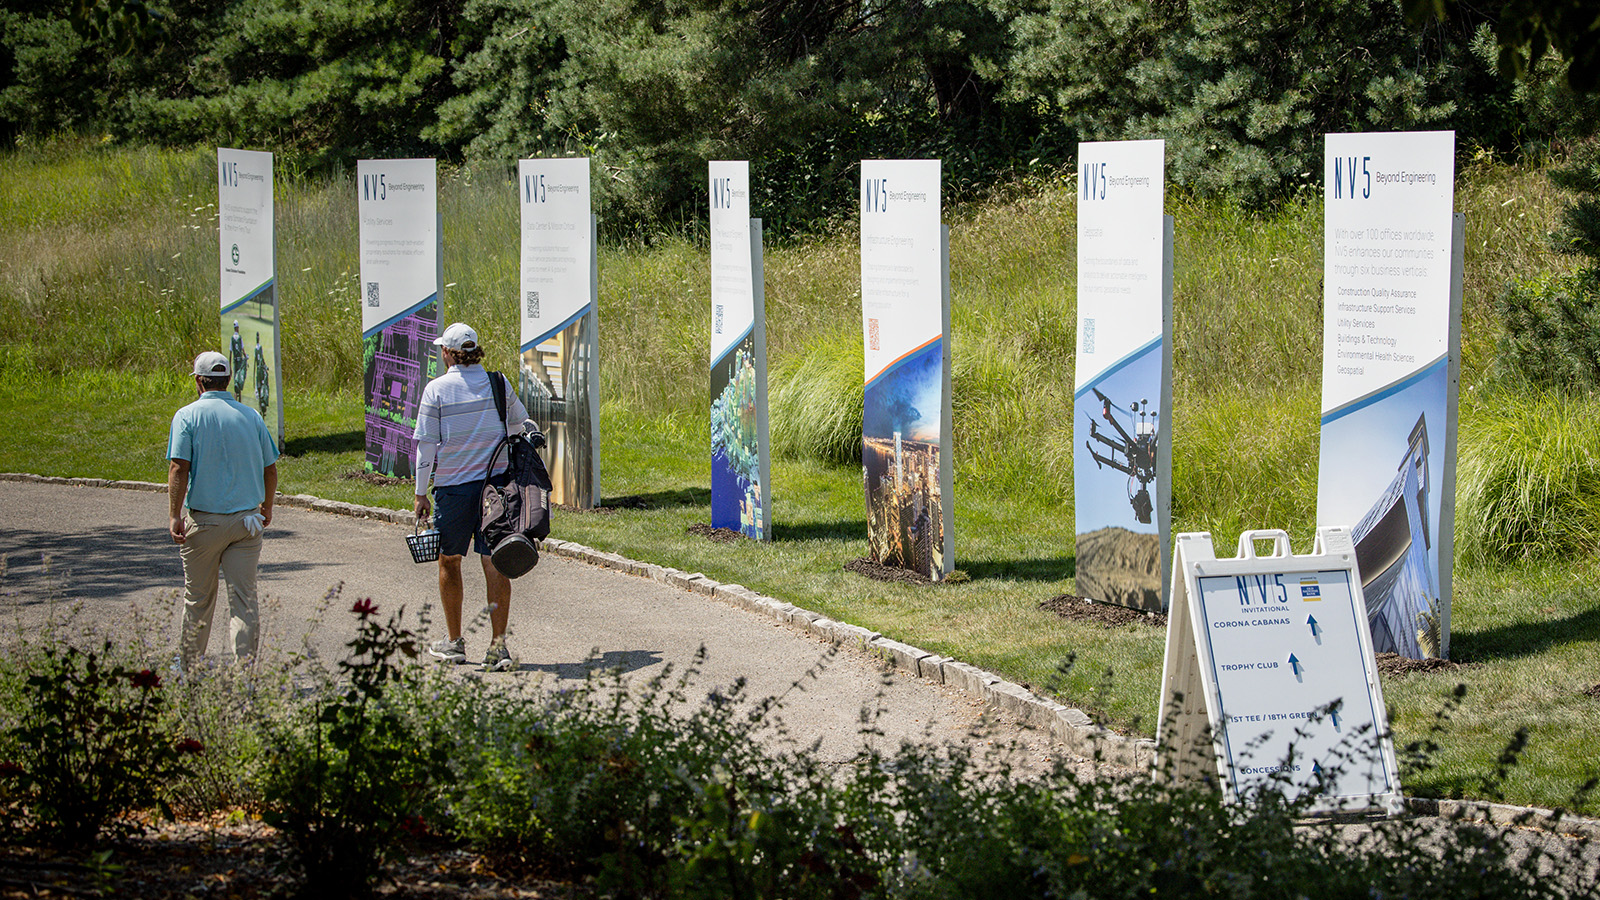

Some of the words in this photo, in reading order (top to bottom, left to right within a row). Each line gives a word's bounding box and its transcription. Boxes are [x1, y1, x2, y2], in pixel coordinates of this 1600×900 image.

[222, 162, 238, 187] NV5
[1335, 157, 1371, 199] NV5
[1376, 171, 1400, 185] Beyond
[1401, 171, 1436, 185] Engineering
[364, 174, 386, 200] NV5
[388, 183, 403, 192] Beyond
[403, 183, 425, 192] Engineering
[1083, 163, 1107, 200] NV5
[1109, 175, 1125, 187] Beyond
[1125, 175, 1150, 187] Engineering
[525, 175, 546, 203] NV5
[547, 184, 559, 193] Beyond
[559, 184, 579, 194] Engineering
[713, 178, 731, 208] NV5
[866, 179, 887, 213] NV5
[889, 190, 903, 201] Beyond
[904, 191, 926, 202] Engineering
[1335, 228, 1349, 239] With
[1350, 230, 1365, 239] over
[1366, 229, 1379, 239] 100
[1380, 229, 1402, 240] offices
[1335, 246, 1347, 257] NV5
[1348, 247, 1380, 258] enhances
[1383, 249, 1394, 258] our
[1394, 247, 1434, 259] communities
[1335, 263, 1359, 277] through
[1360, 265, 1370, 275] six
[1370, 265, 1400, 276] business
[1337, 286, 1370, 296] Construction
[1371, 288, 1390, 299] Quality
[1391, 289, 1417, 299] Assurance
[1338, 302, 1372, 312] Infrastructure
[1373, 304, 1394, 315] Support
[1395, 304, 1416, 314] Services
[1337, 318, 1352, 329] Utility
[1352, 319, 1375, 329] Services
[1338, 334, 1361, 345] Buildings
[1361, 335, 1366, 344] &
[1367, 335, 1397, 347] Technology
[1337, 349, 1374, 360] Environmental
[1375, 351, 1392, 361] Health
[1393, 352, 1415, 363] Sciences
[1337, 365, 1364, 376] Geospatial
[1241, 605, 1290, 614] INVITATIONAL
[1213, 620, 1250, 628] CORONA
[1251, 618, 1290, 626] CABANAS
[1221, 663, 1255, 671] TROPHY
[1256, 661, 1279, 670] CLUB
[1230, 715, 1244, 723] 1ST
[1245, 714, 1261, 722] TEE
[1262, 714, 1266, 722] /
